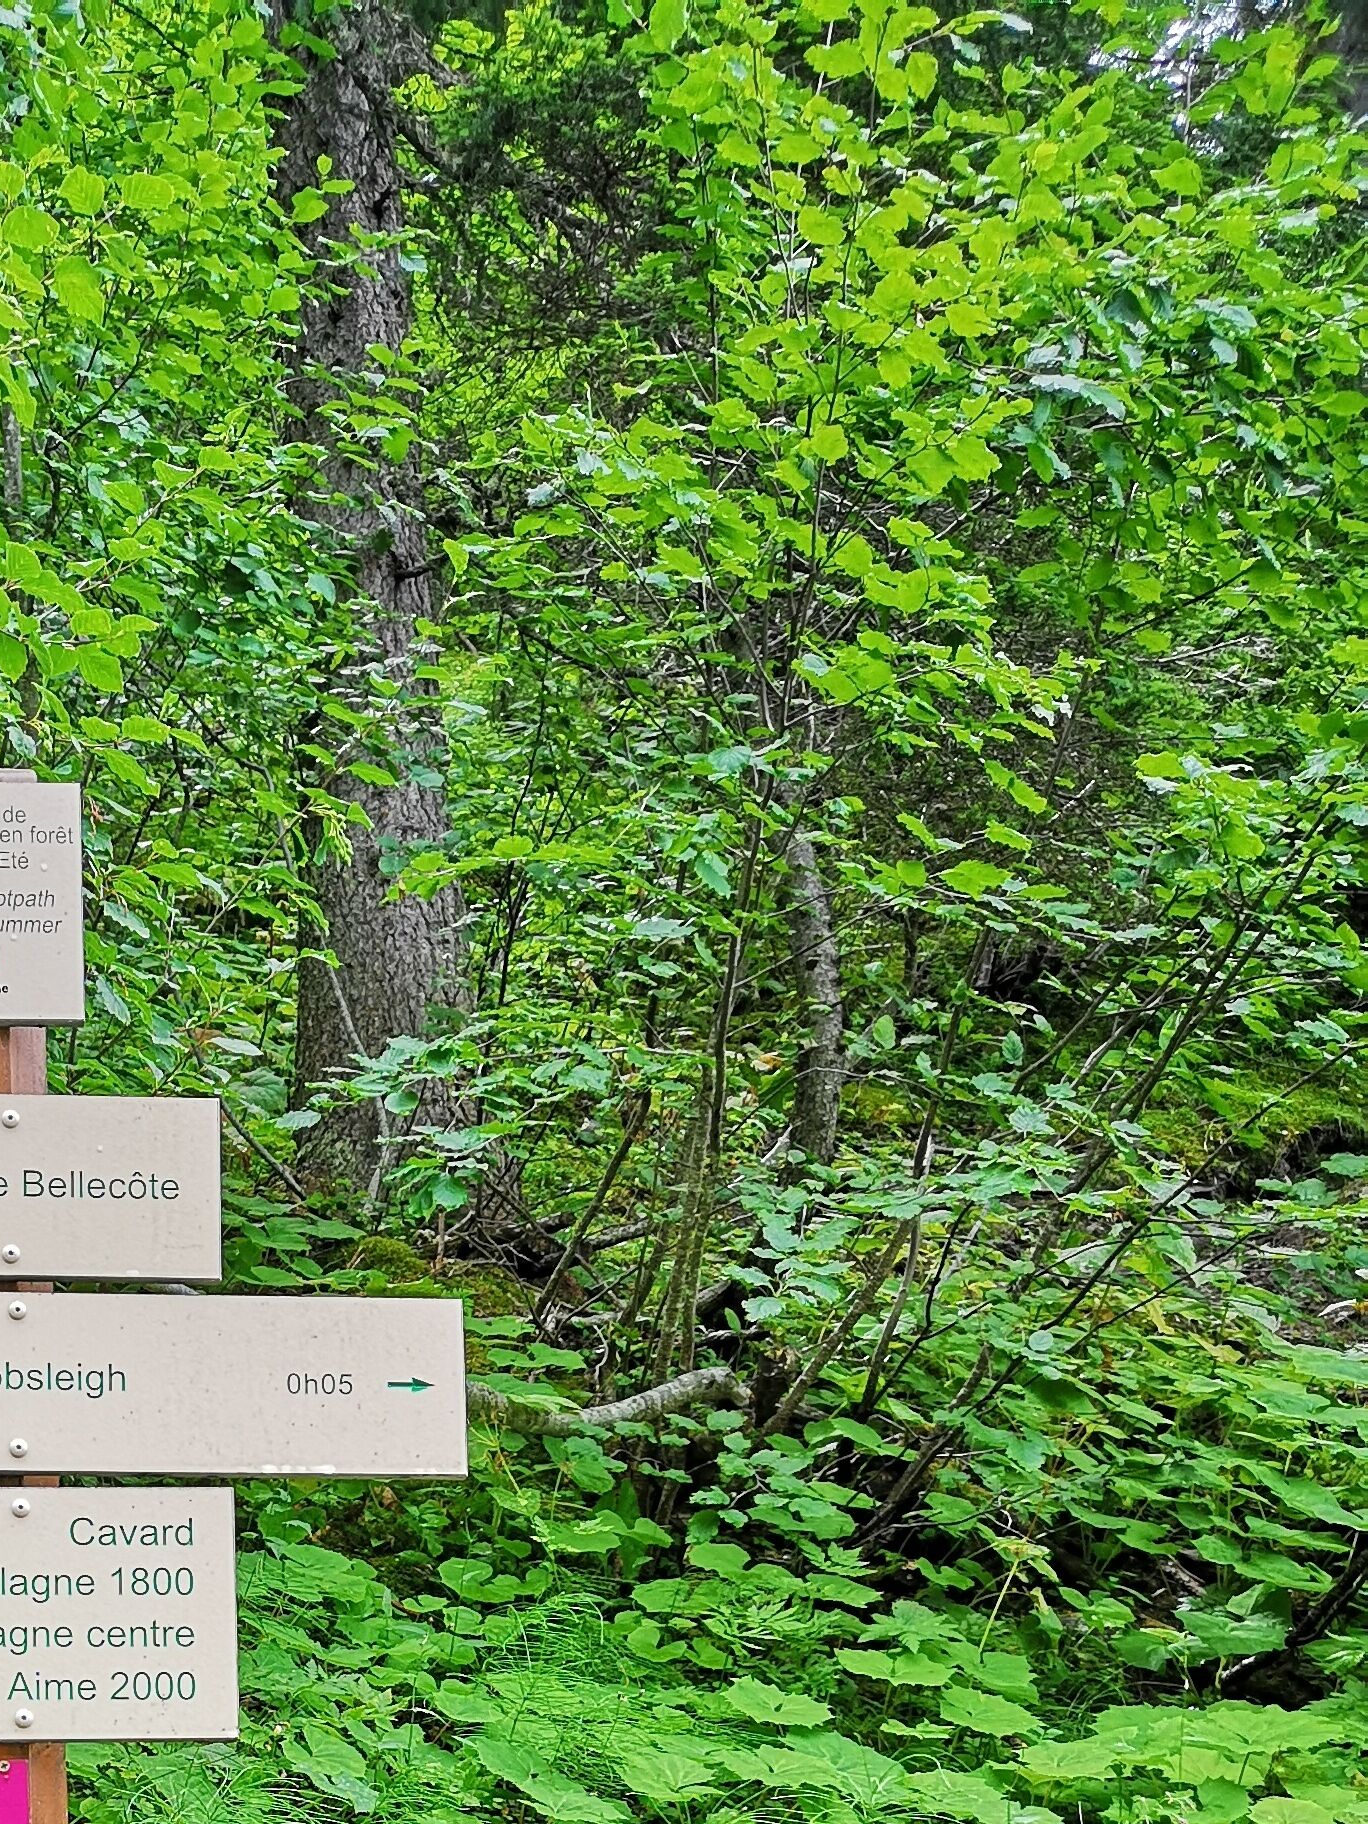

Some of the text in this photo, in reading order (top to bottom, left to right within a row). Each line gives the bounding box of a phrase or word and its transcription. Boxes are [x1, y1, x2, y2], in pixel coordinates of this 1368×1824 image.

[2, 805, 27, 824] de
[0, 829, 23, 843] en
[30, 825, 74, 845] forêt
[23, 1169, 180, 1200] Bellecôte
[286, 1372, 353, 1395] 0h05
[69, 1517, 194, 1547] Cavard
[111, 1567, 194, 1596] 1800
[87, 1619, 195, 1648] centre
[7, 1671, 196, 1702] Aime 2000
